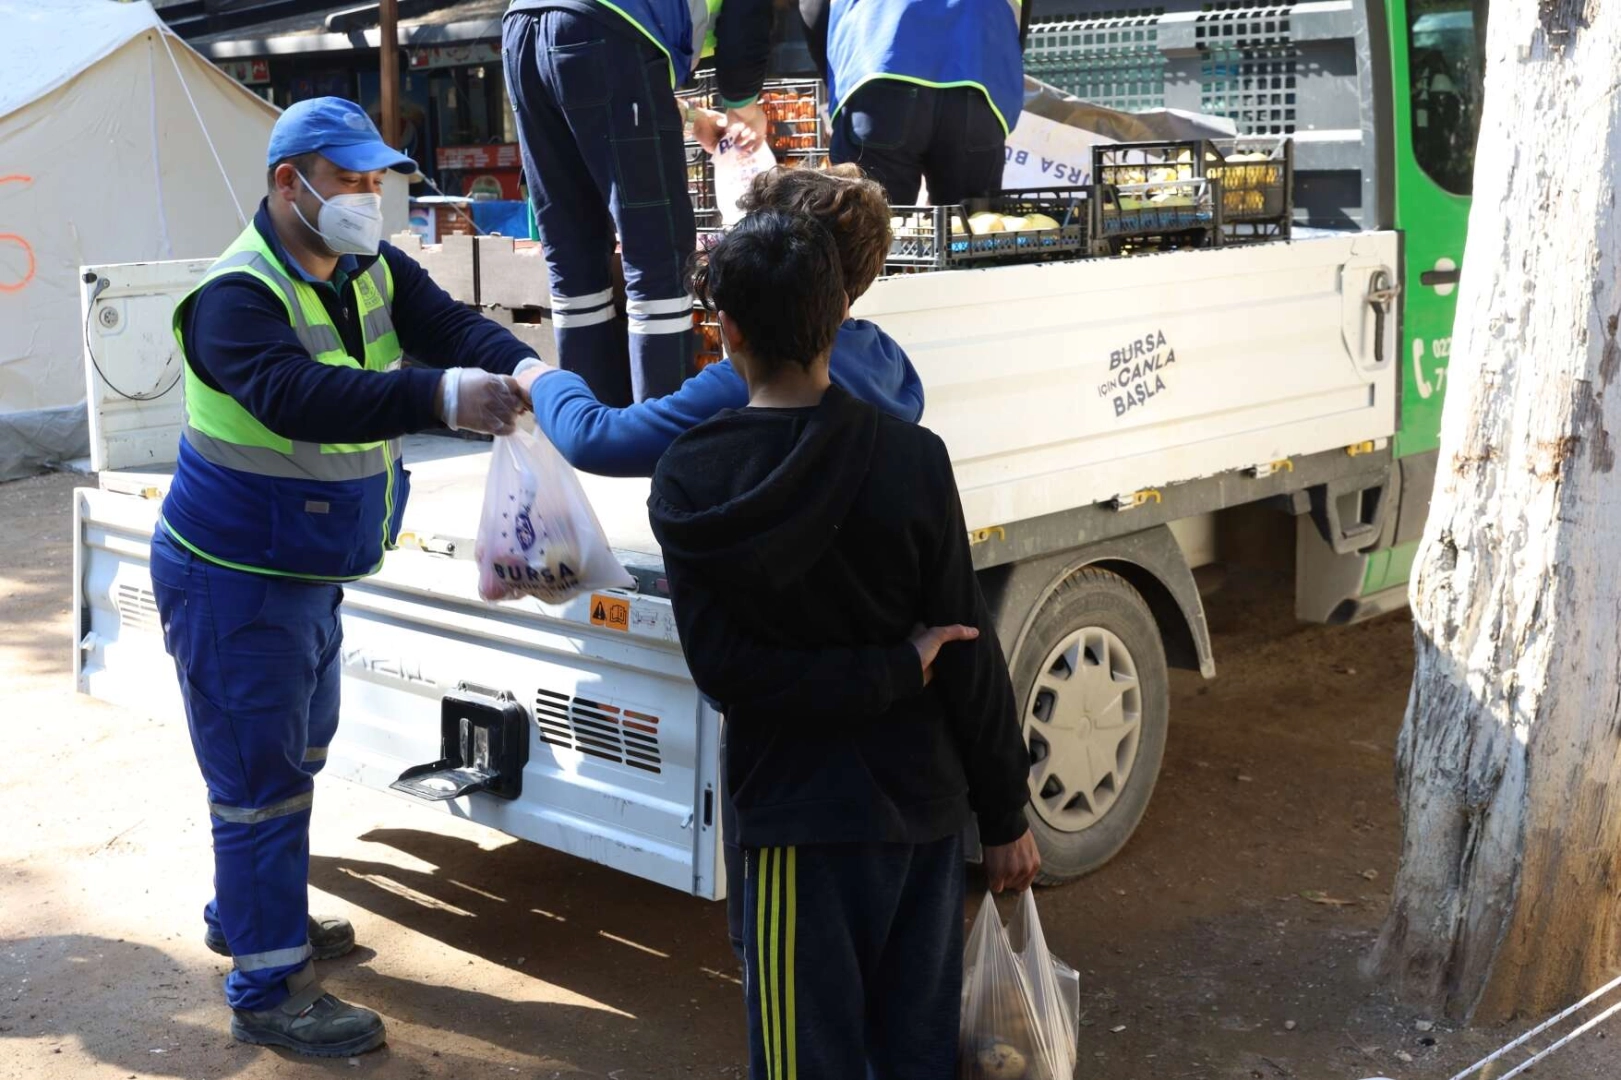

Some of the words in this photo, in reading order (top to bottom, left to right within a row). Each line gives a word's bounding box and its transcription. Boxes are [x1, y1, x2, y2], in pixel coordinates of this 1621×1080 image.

[1109, 329, 1167, 371] BURSA
[1117, 347, 1176, 387] CANLA
[1112, 373, 1167, 418] BAŞLA
[493, 562, 579, 584] BURSA
